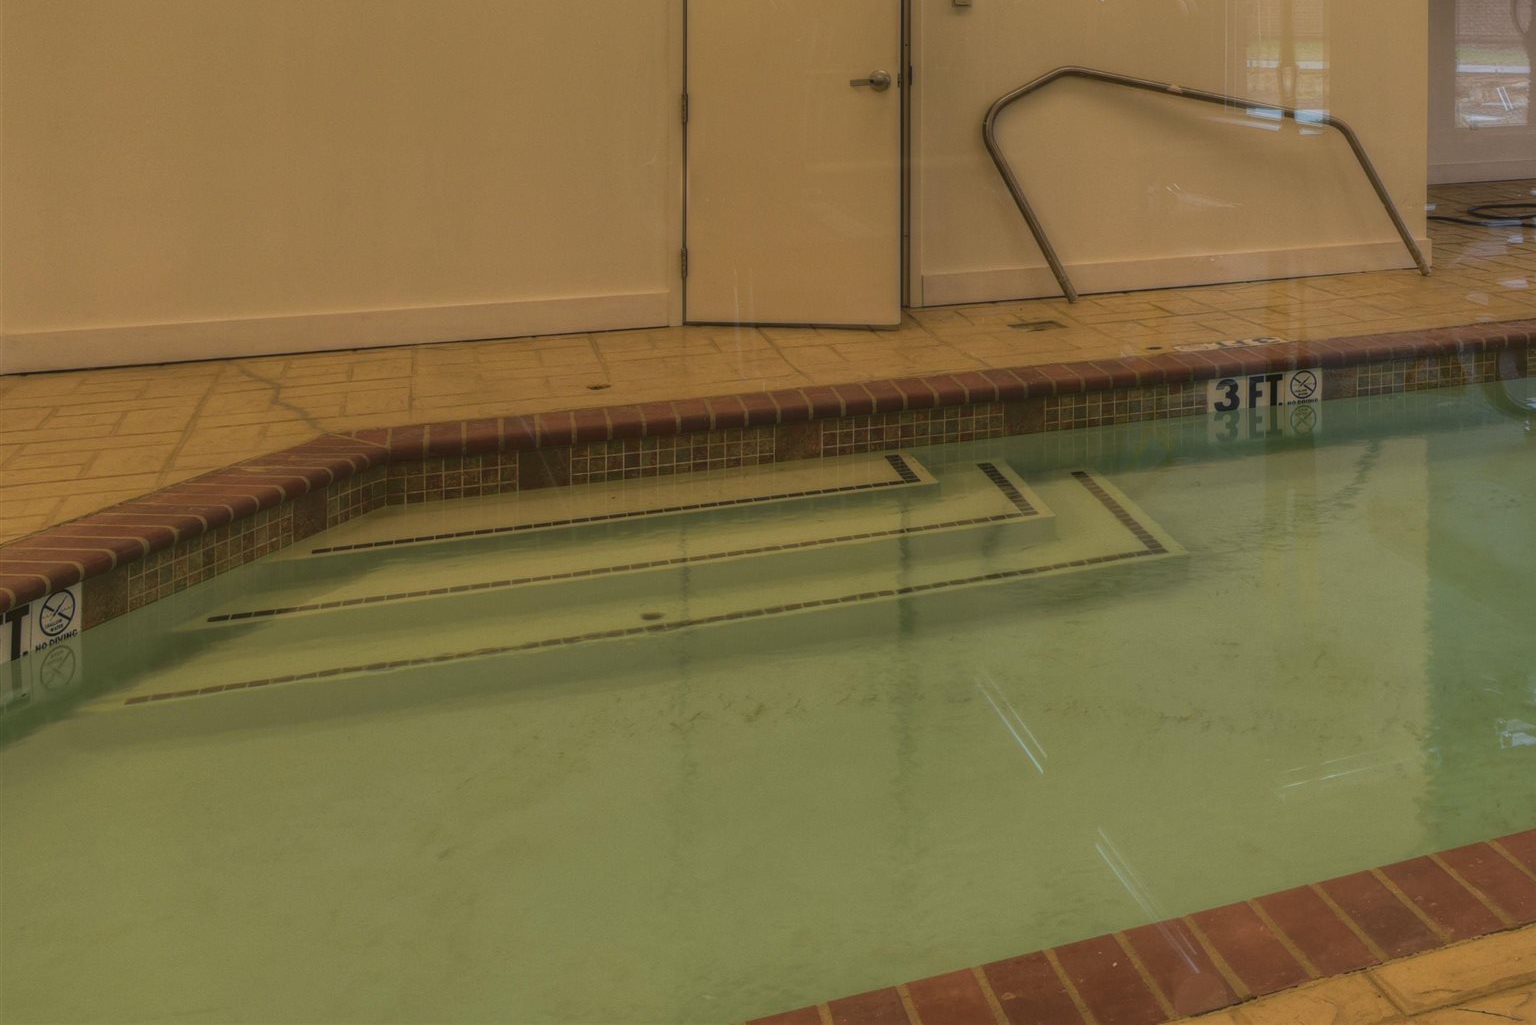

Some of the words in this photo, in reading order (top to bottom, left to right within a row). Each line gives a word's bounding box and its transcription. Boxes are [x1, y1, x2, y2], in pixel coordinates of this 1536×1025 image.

[1214, 378, 1240, 412] 3
[35, 642, 48, 653] NO
[49, 629, 78, 647] DIVING
